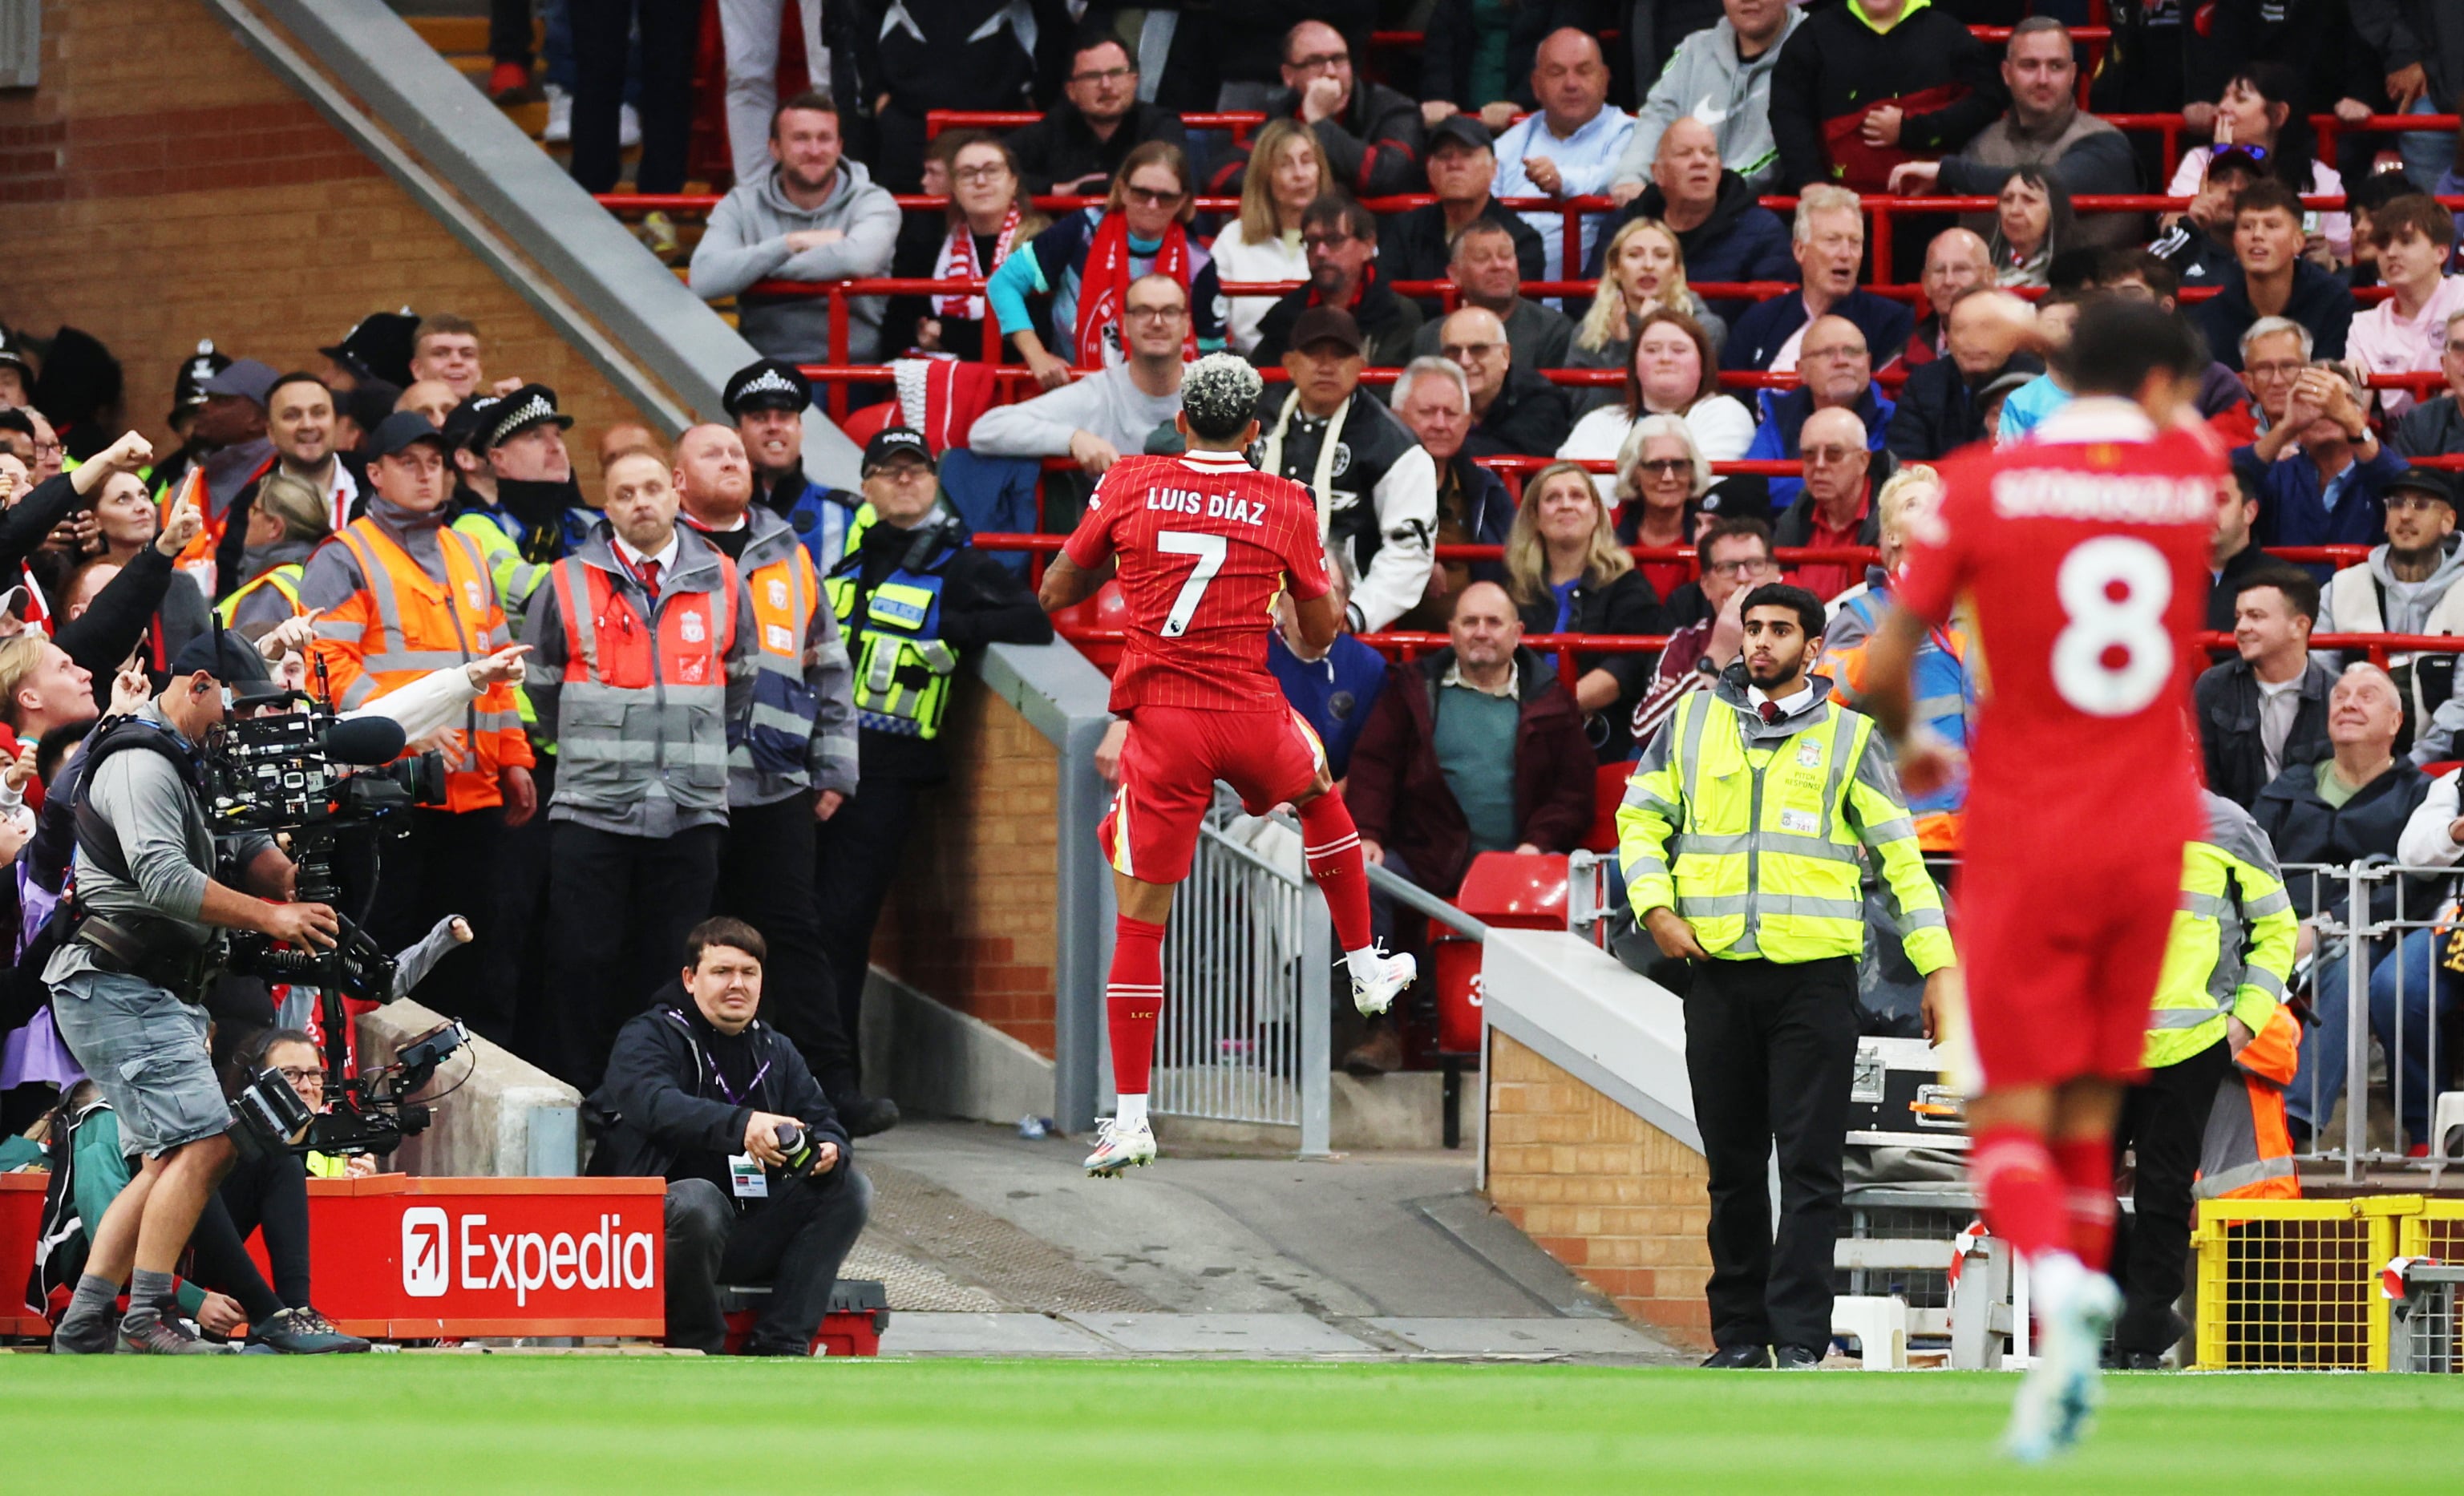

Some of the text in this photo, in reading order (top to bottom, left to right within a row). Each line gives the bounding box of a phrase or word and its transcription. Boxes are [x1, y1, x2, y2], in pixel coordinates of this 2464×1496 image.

[883, 432, 921, 446] POLICE
[1147, 487, 1267, 526] LUIS DÍAZ
[1157, 530, 1228, 637] 7
[2049, 532, 2173, 717] 8
[1785, 778, 1821, 791] RESPONSE
[1794, 771, 1815, 781] PITCH
[461, 1214, 653, 1307] Expedia
